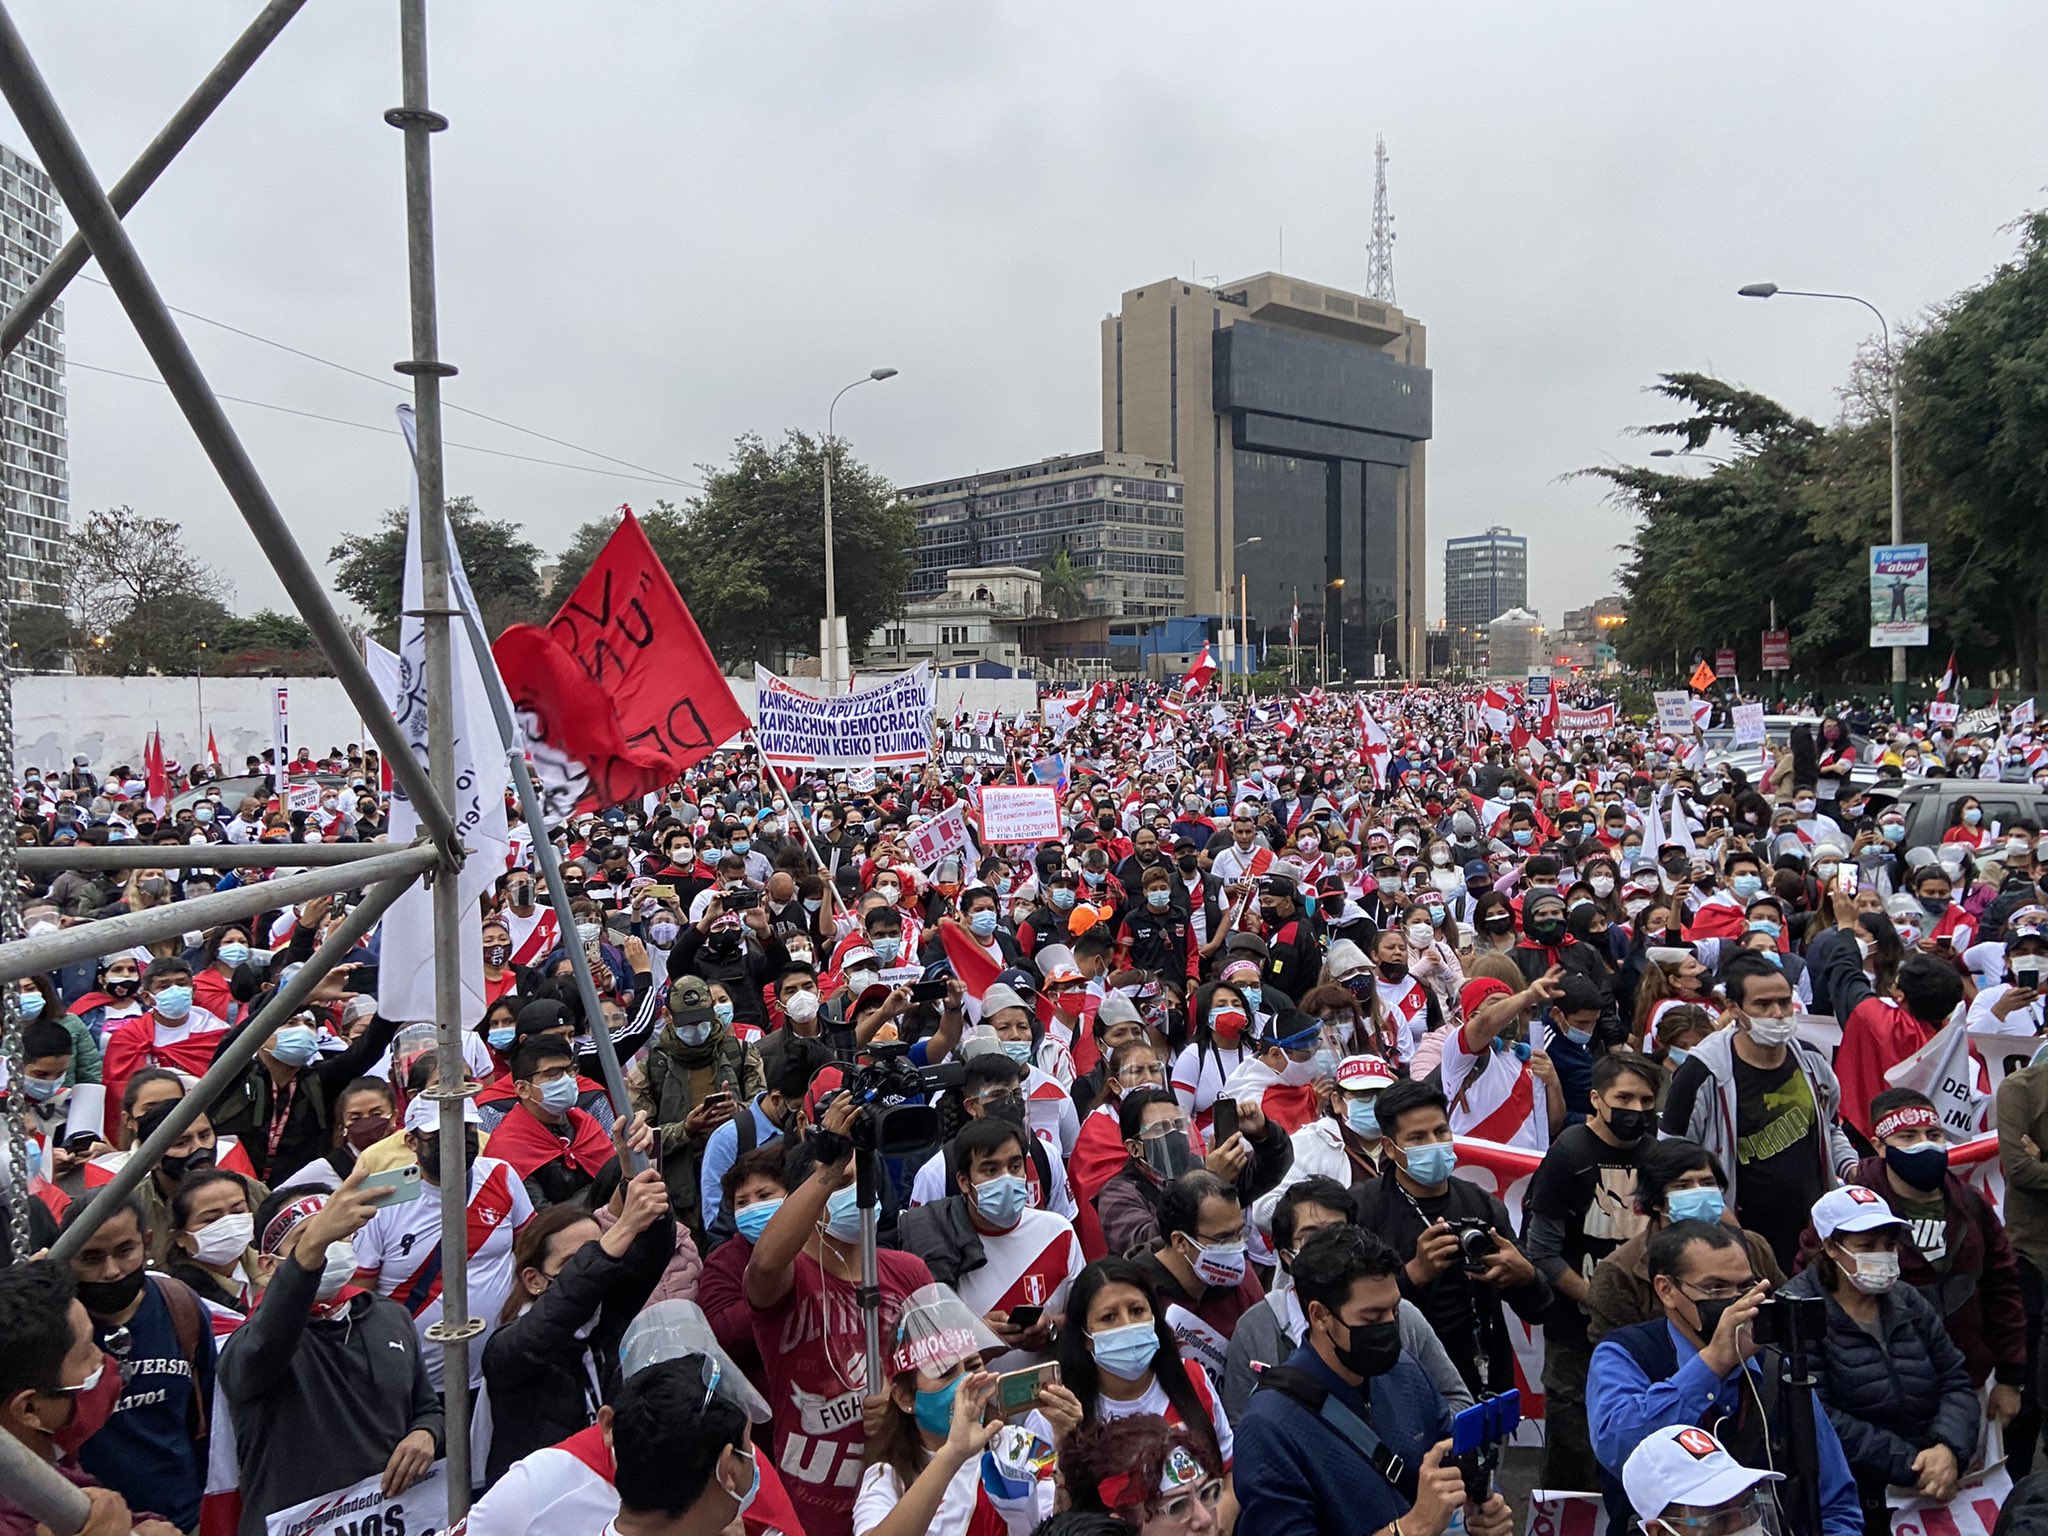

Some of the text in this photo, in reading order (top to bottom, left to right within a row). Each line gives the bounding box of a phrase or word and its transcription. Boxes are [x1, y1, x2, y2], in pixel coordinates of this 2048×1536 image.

[1887, 561, 1920, 573] abue
[893, 673, 916, 691] 2021
[760, 682, 926, 719] KAWSACHUN APU LLAQTA PERÚ
[760, 711, 837, 737] KAWSACHUN
[841, 709, 924, 737] DEMOCRACI
[833, 736, 871, 756] KEIKO
[952, 732, 996, 752] NO AL
[294, 799, 306, 808] NO
[915, 814, 947, 836] NO AL
[1737, 1105, 1809, 1165] PUMA
[893, 1350, 908, 1370] TE
[909, 1336, 939, 1365] AMO
[820, 1401, 864, 1429] FIGH
